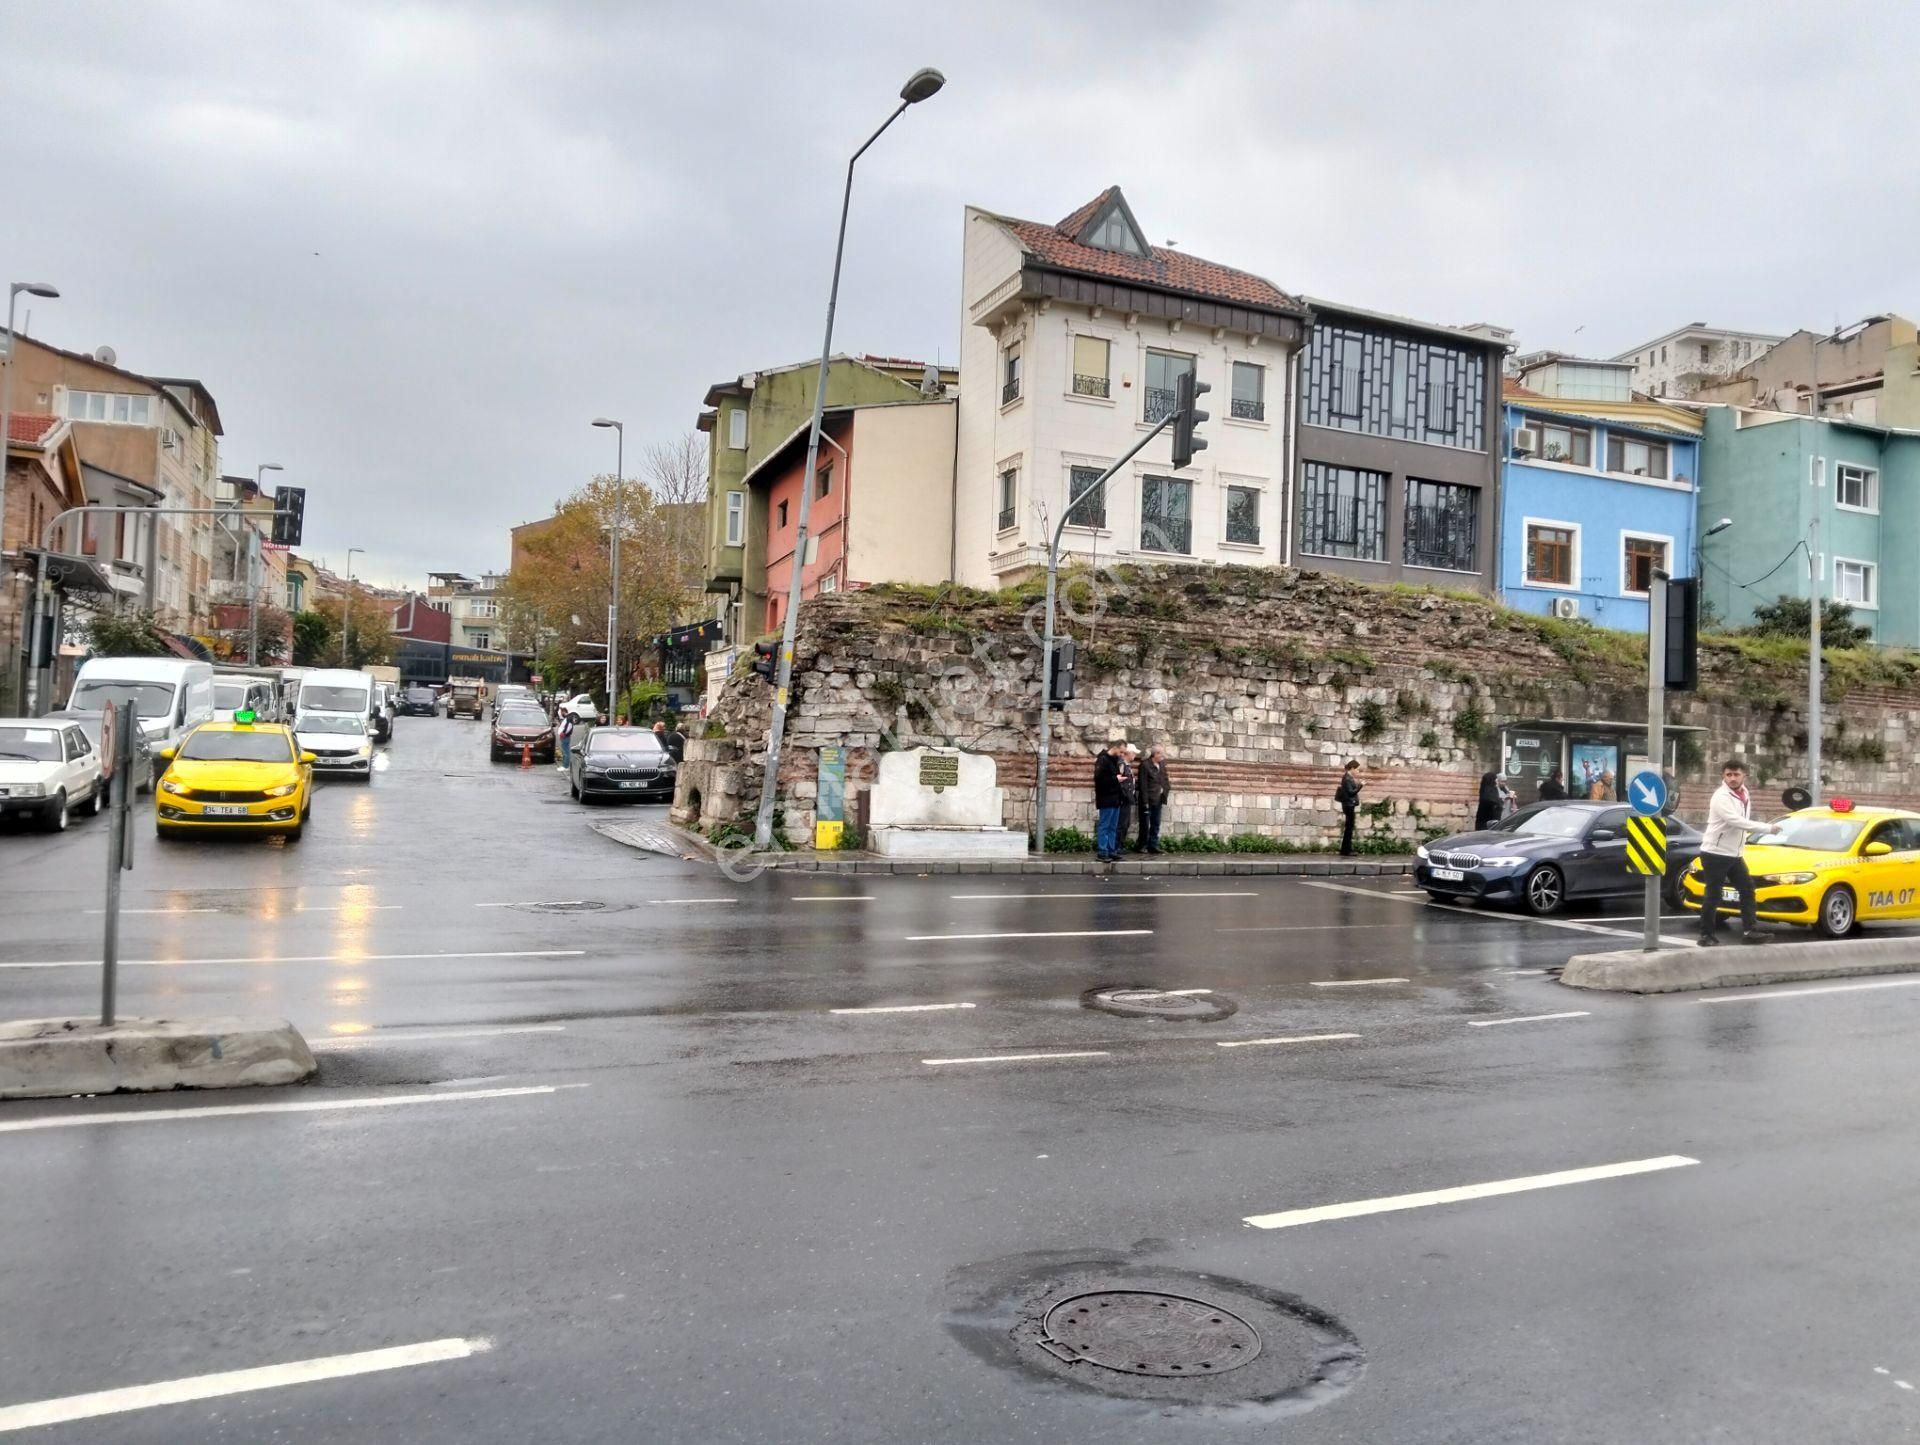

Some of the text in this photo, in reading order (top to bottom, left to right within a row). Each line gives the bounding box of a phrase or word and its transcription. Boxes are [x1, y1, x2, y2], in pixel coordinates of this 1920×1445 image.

[207, 806, 216, 814] 34
[1868, 888, 1915, 907] TAA 07
